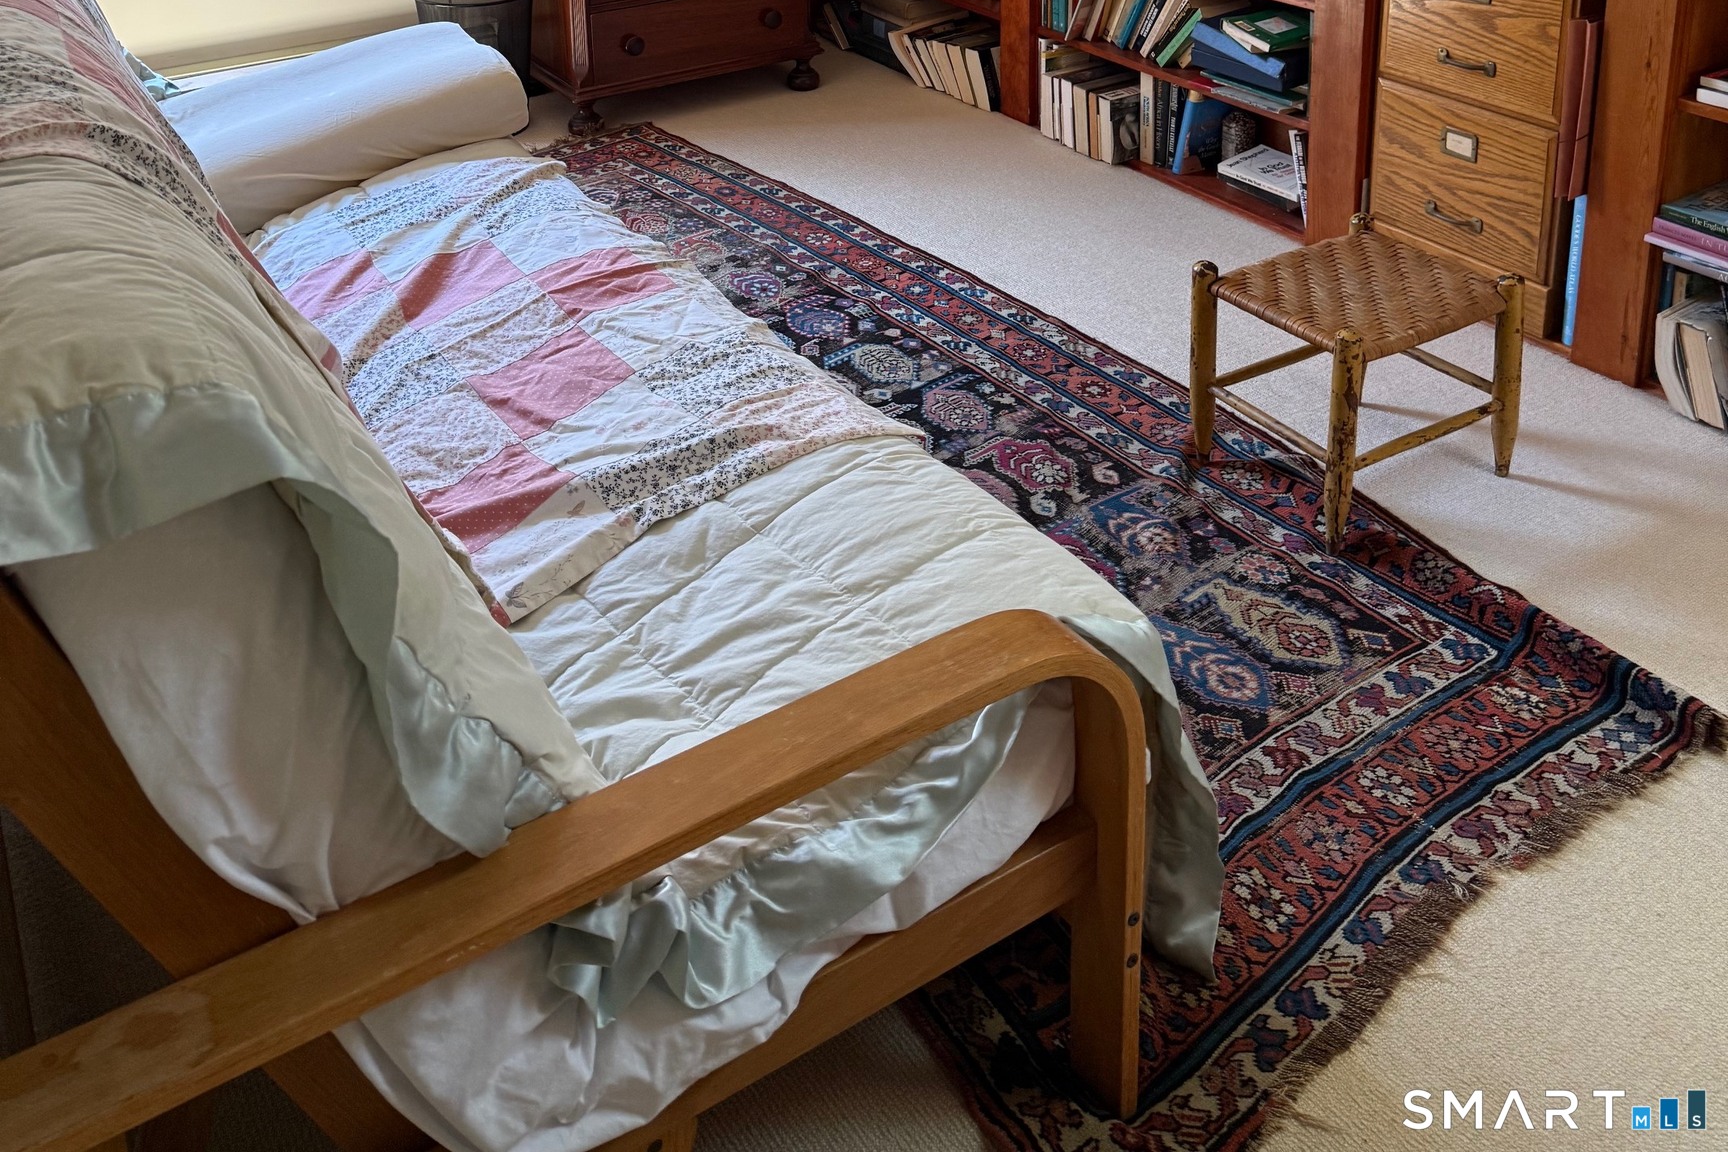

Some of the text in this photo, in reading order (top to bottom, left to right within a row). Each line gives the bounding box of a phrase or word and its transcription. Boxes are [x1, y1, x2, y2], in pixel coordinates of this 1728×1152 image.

[1226, 147, 1270, 169] Jean Shepherd
[1658, 224, 1681, 236] FRANCES
[1681, 232, 1697, 241] MAYES
[1701, 237, 1713, 248] IN
[1690, 216, 1703, 226] The
[1703, 219, 1726, 234] English
[1572, 247, 1580, 276] WORLD
